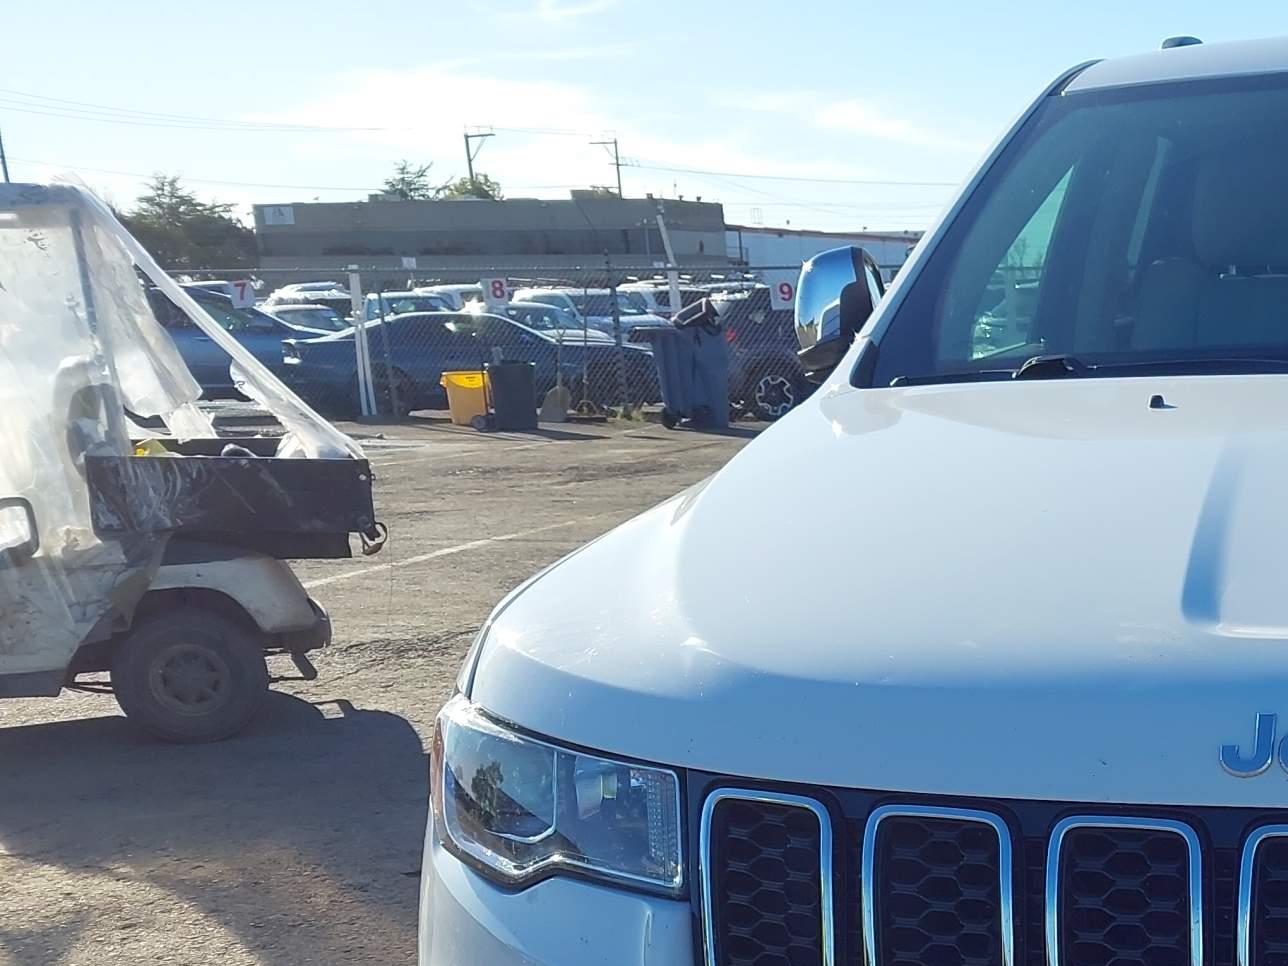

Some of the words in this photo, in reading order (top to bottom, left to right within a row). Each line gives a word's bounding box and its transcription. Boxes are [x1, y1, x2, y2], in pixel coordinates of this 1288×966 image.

[233, 281, 247, 301] 7
[491, 279, 505, 299] 8
[779, 282, 793, 302] 9
